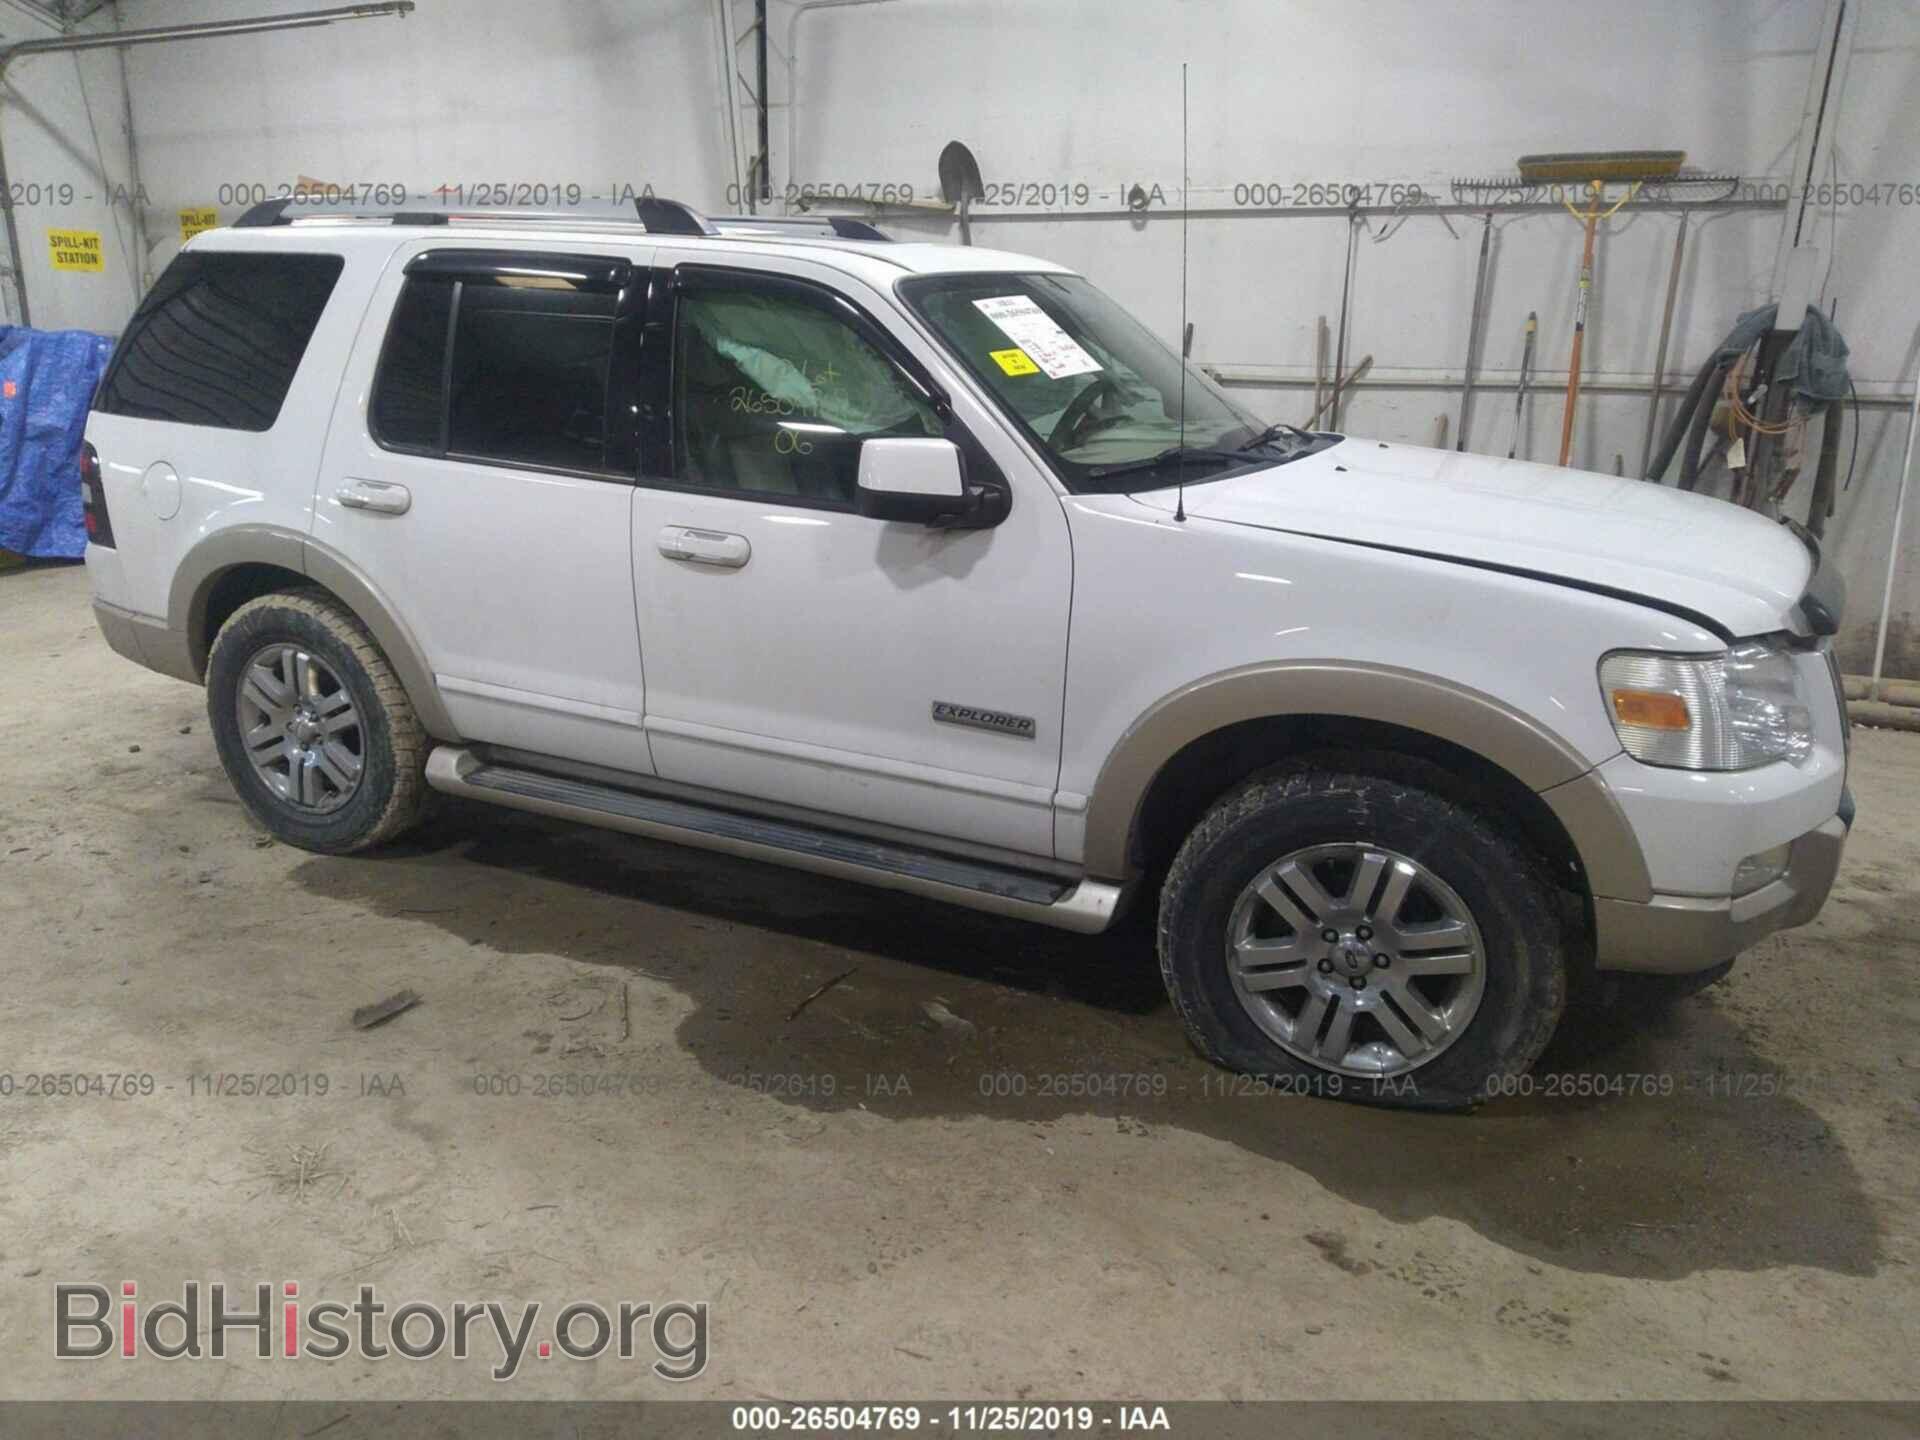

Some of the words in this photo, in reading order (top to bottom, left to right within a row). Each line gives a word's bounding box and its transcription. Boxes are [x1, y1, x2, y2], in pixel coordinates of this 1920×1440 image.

[50, 235, 99, 250] SPILL-KIT
[56, 251, 98, 265] STATION
[934, 703, 1032, 731] EXPLORER
